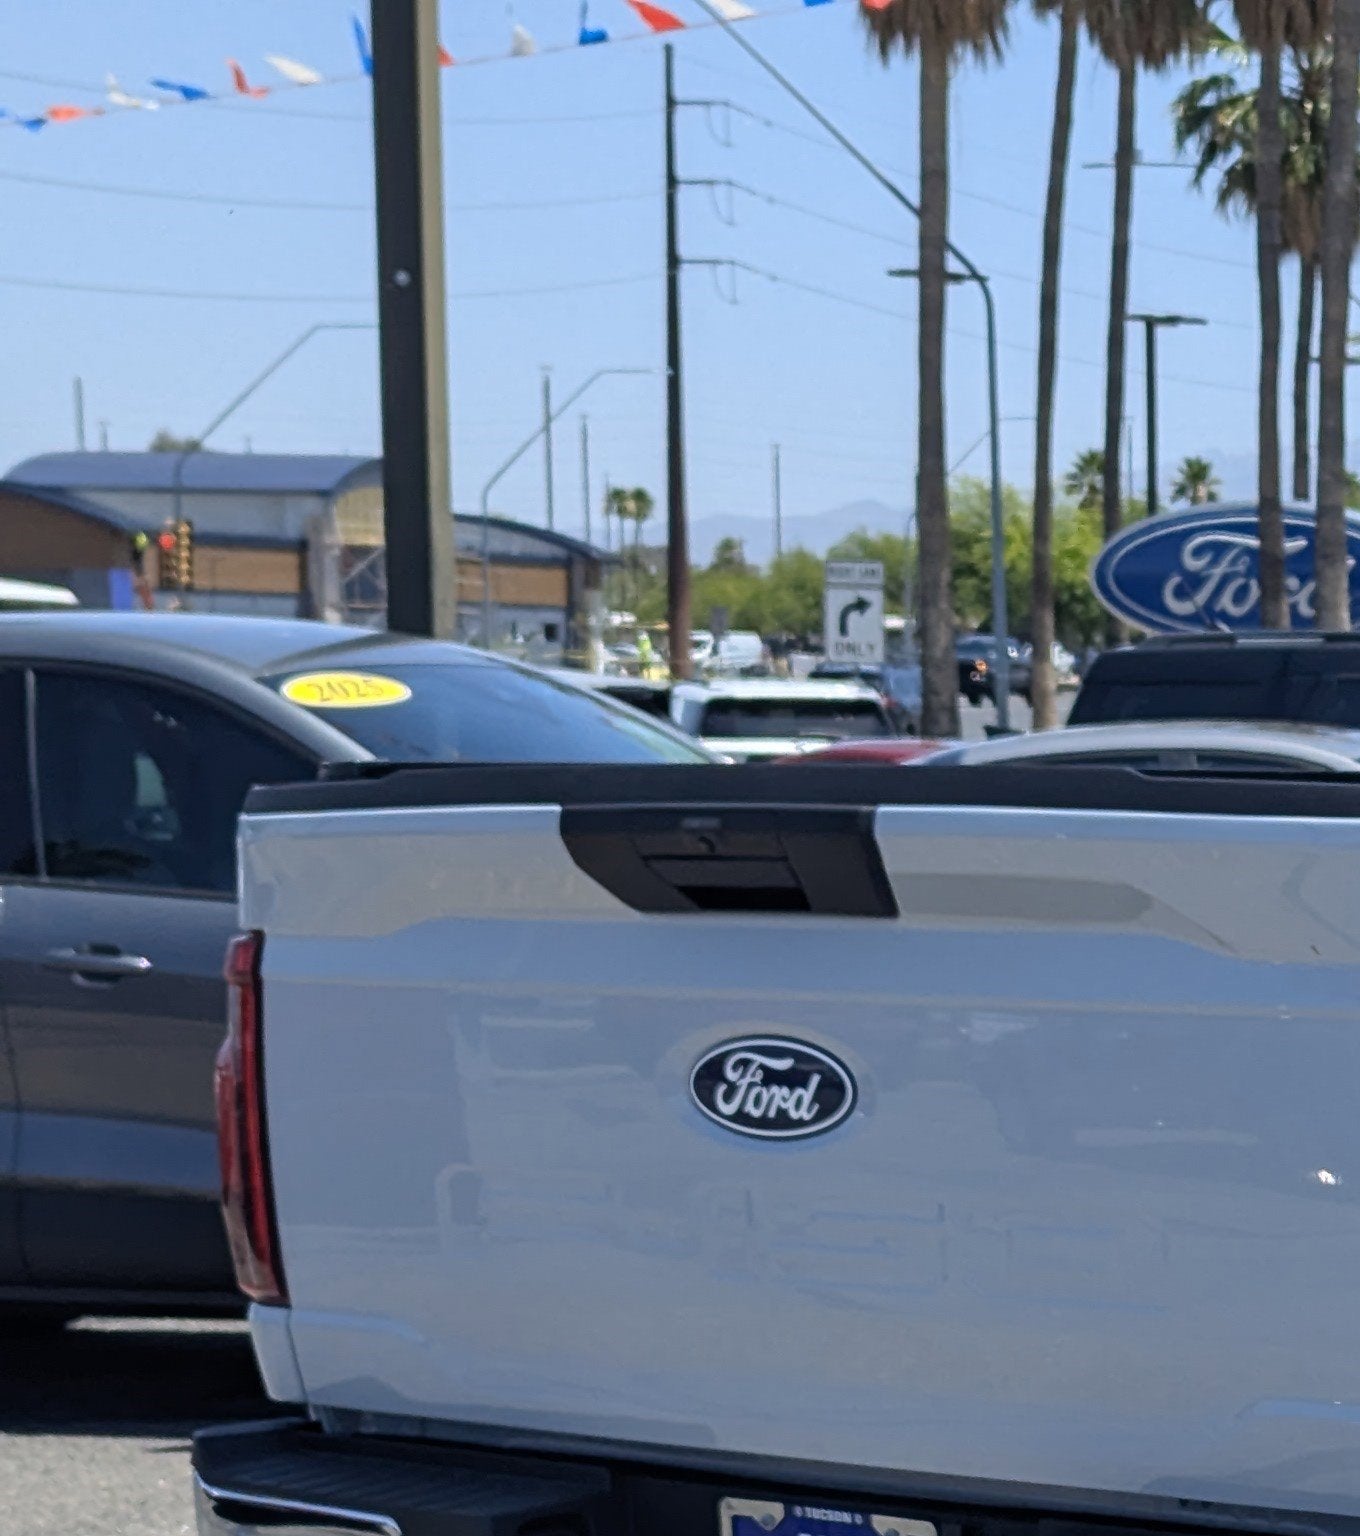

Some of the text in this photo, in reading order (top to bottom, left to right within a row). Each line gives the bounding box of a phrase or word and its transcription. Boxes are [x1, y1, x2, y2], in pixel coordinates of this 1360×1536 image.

[834, 642, 875, 657] ONLY
[306, 679, 384, 702] 2025
[716, 1052, 821, 1121] Ford
